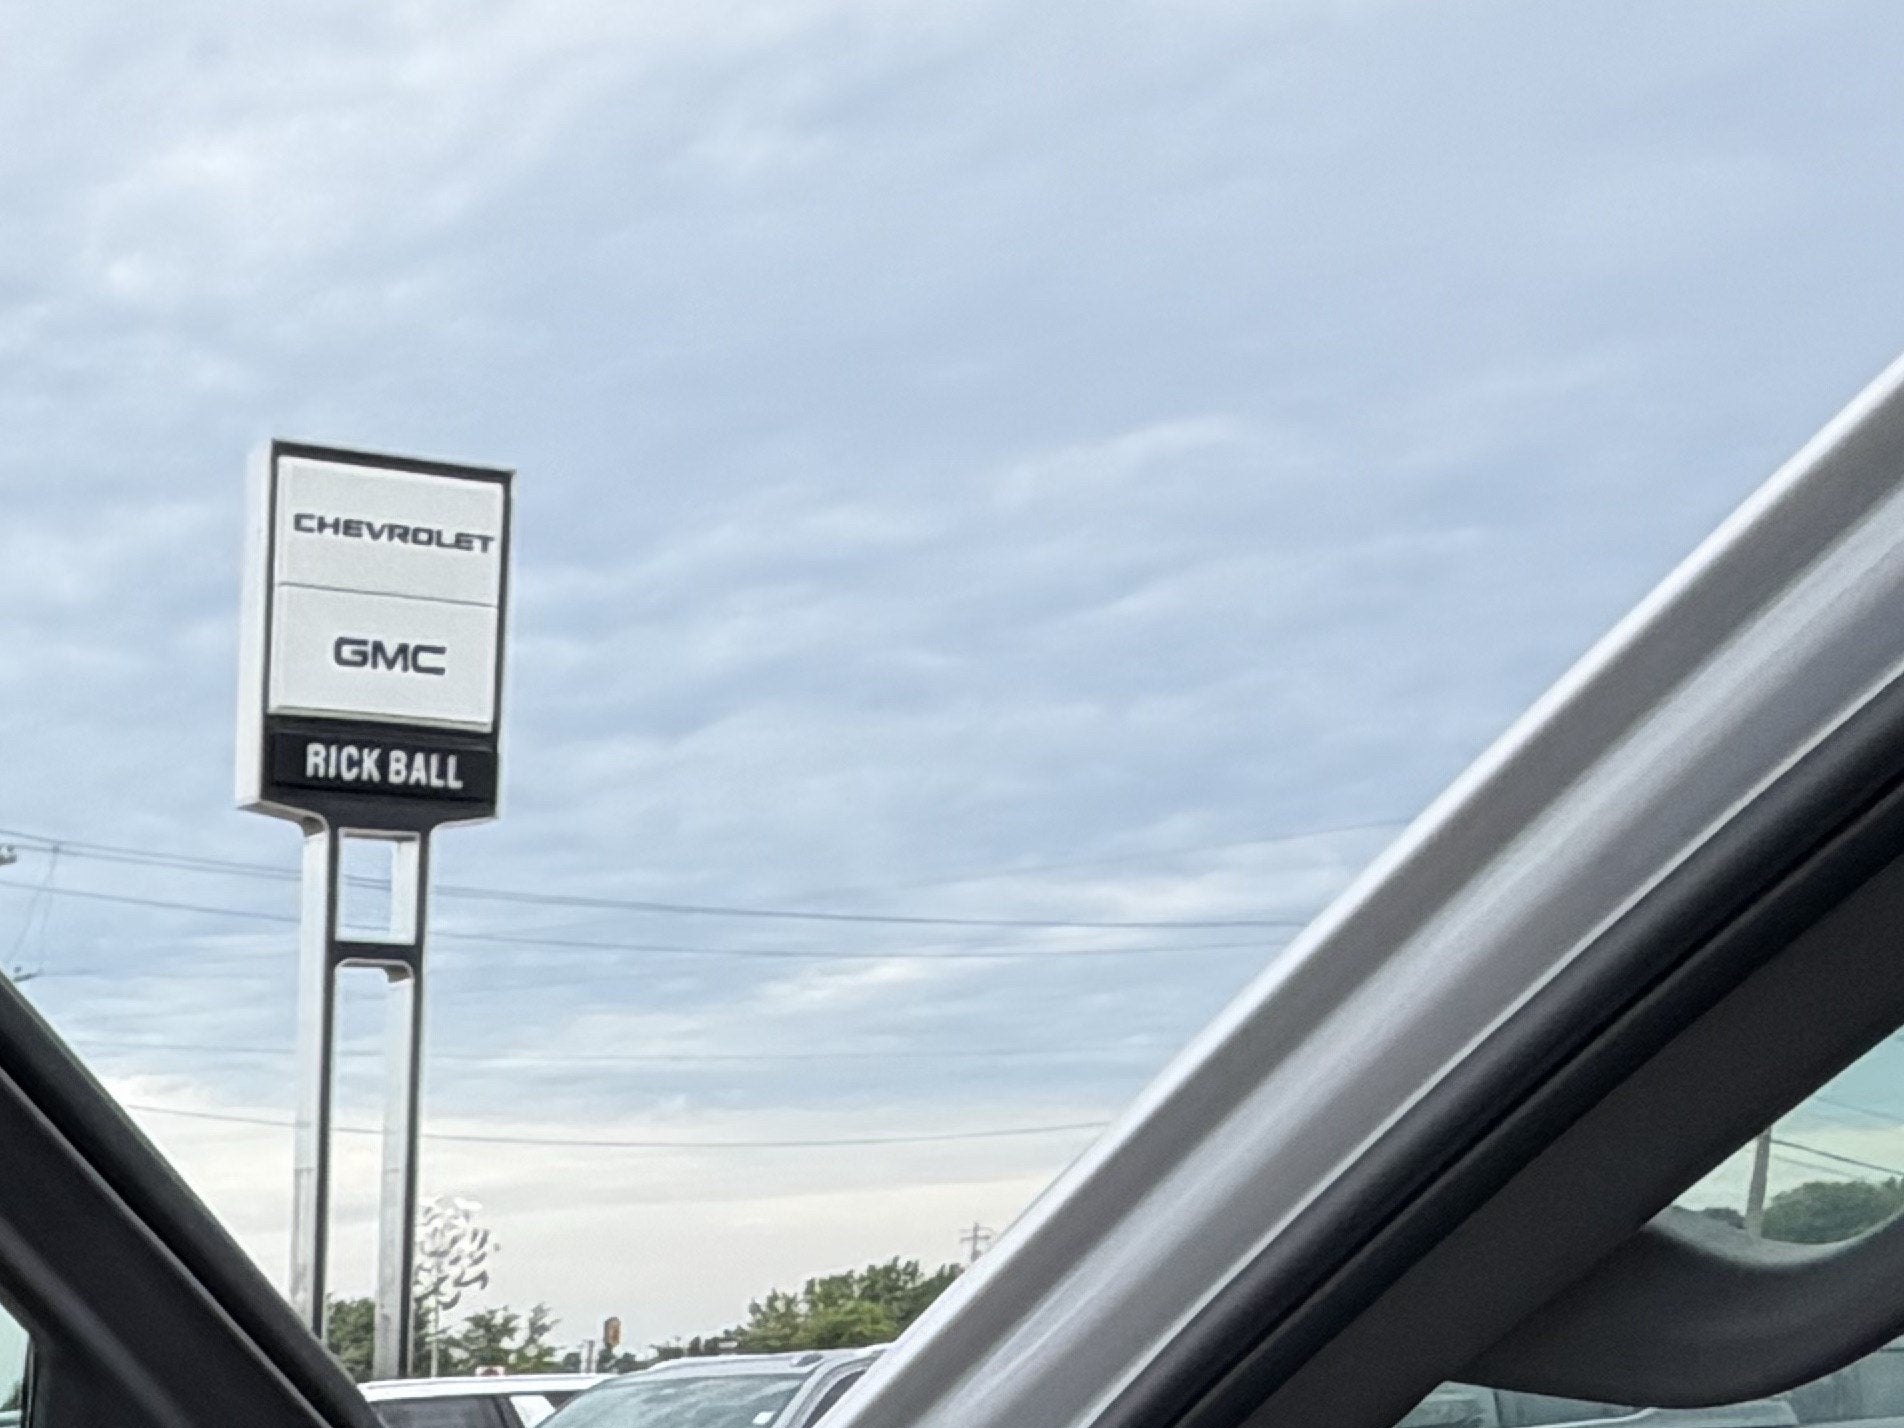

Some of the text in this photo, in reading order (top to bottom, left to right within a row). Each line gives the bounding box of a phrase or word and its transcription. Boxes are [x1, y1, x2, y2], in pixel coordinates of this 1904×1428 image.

[293, 512, 495, 554] CHEVROLET
[333, 636, 447, 676] GMC
[305, 742, 464, 790] RICK BALL
